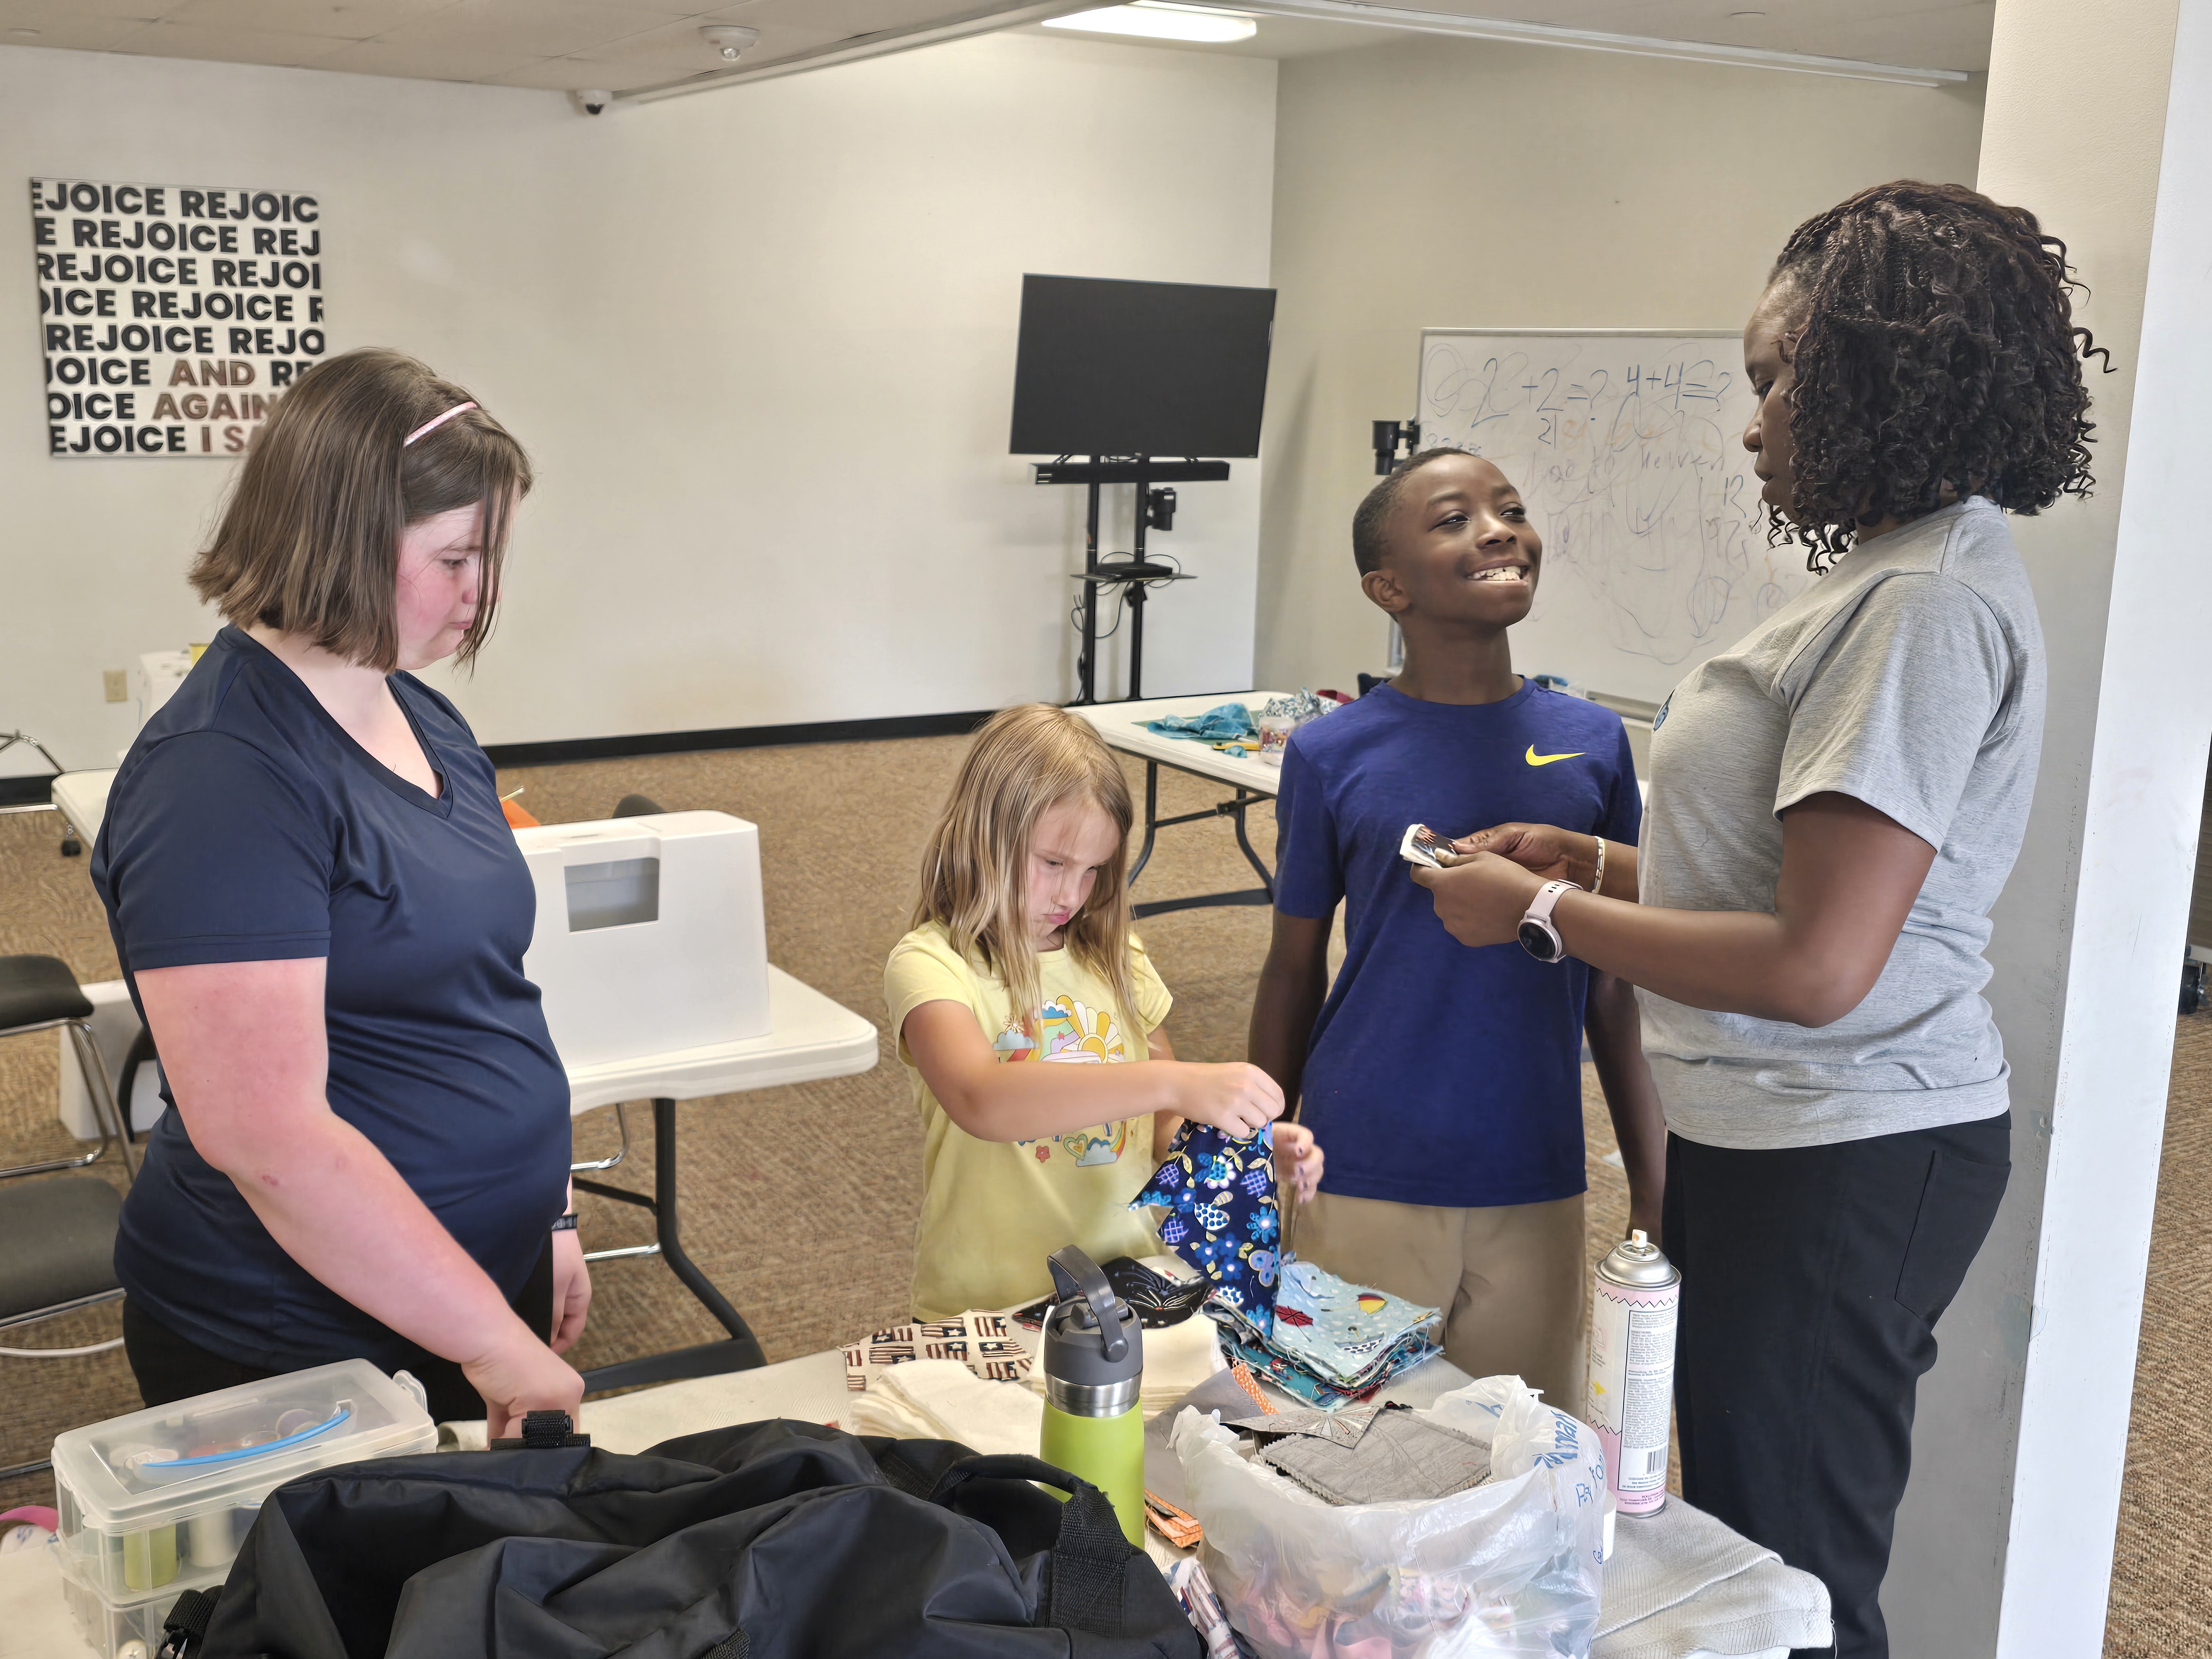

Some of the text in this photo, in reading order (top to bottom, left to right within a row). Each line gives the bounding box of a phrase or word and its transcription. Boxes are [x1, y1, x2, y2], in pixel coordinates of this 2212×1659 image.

[180, 191, 318, 222] REJOIC
[34, 217, 320, 255] E REJOICE REJ
[38, 253, 320, 289] REJOICE REJOI
[132, 291, 293, 321] REJOICE
[46, 325, 325, 354] REJOICE REJO
[168, 359, 255, 385] AND
[51, 426, 186, 452] EJOICE
[202, 426, 211, 452] I
